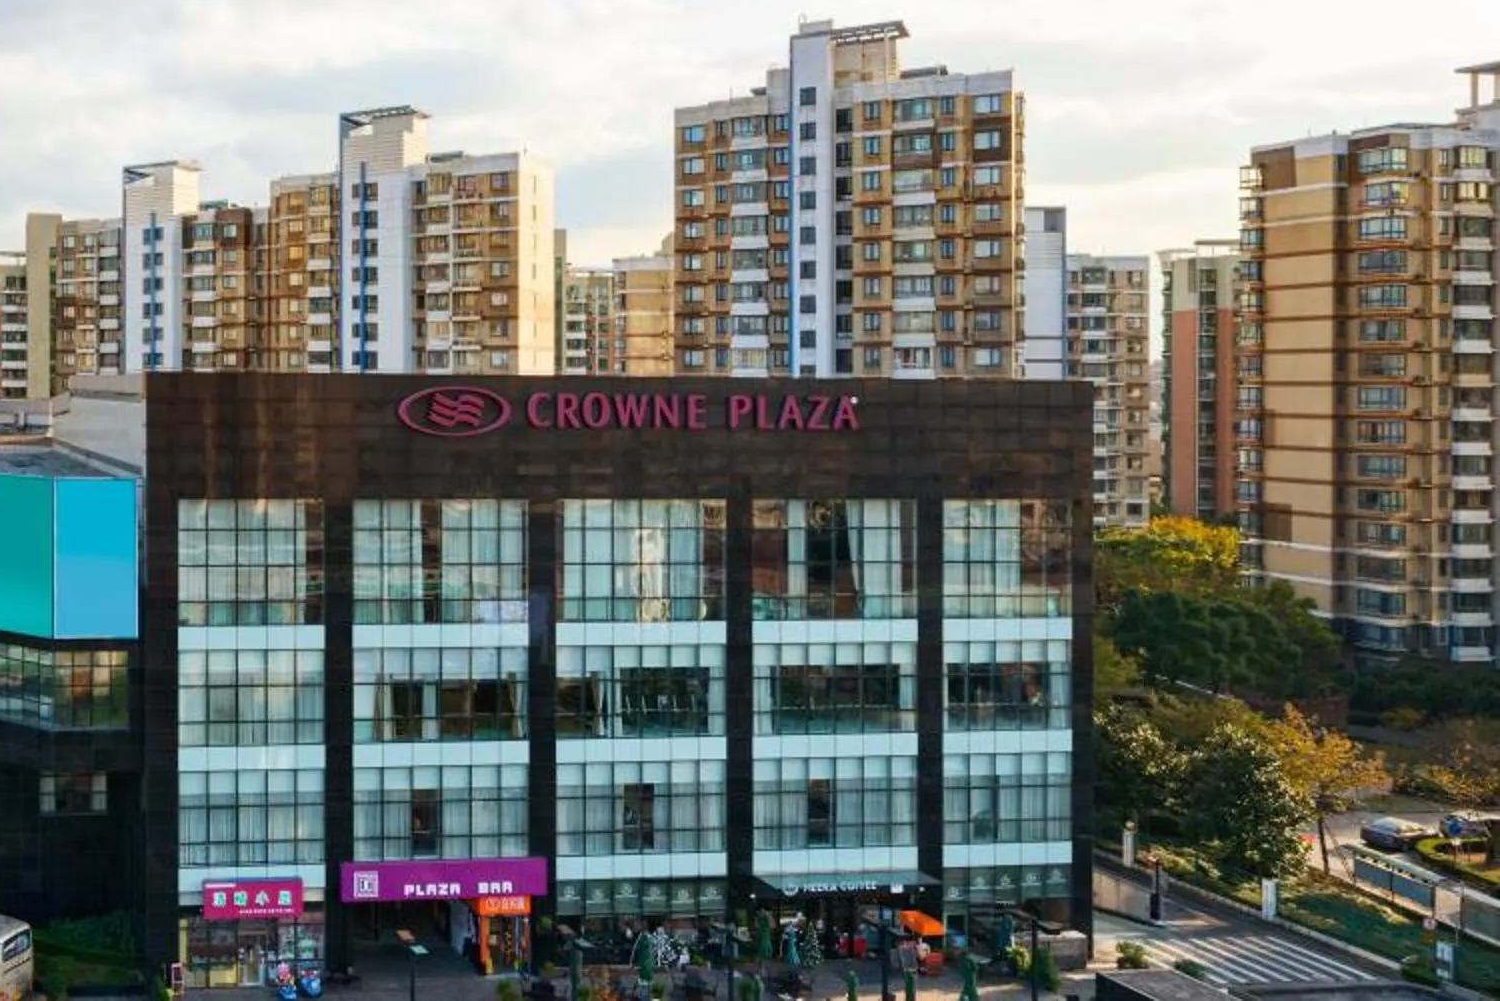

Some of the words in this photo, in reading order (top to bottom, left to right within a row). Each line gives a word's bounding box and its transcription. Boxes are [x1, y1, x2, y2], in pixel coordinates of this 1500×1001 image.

[527, 391, 707, 430] CROWNE
[729, 394, 861, 430] PLAZA
[404, 883, 461, 896] PLAZA
